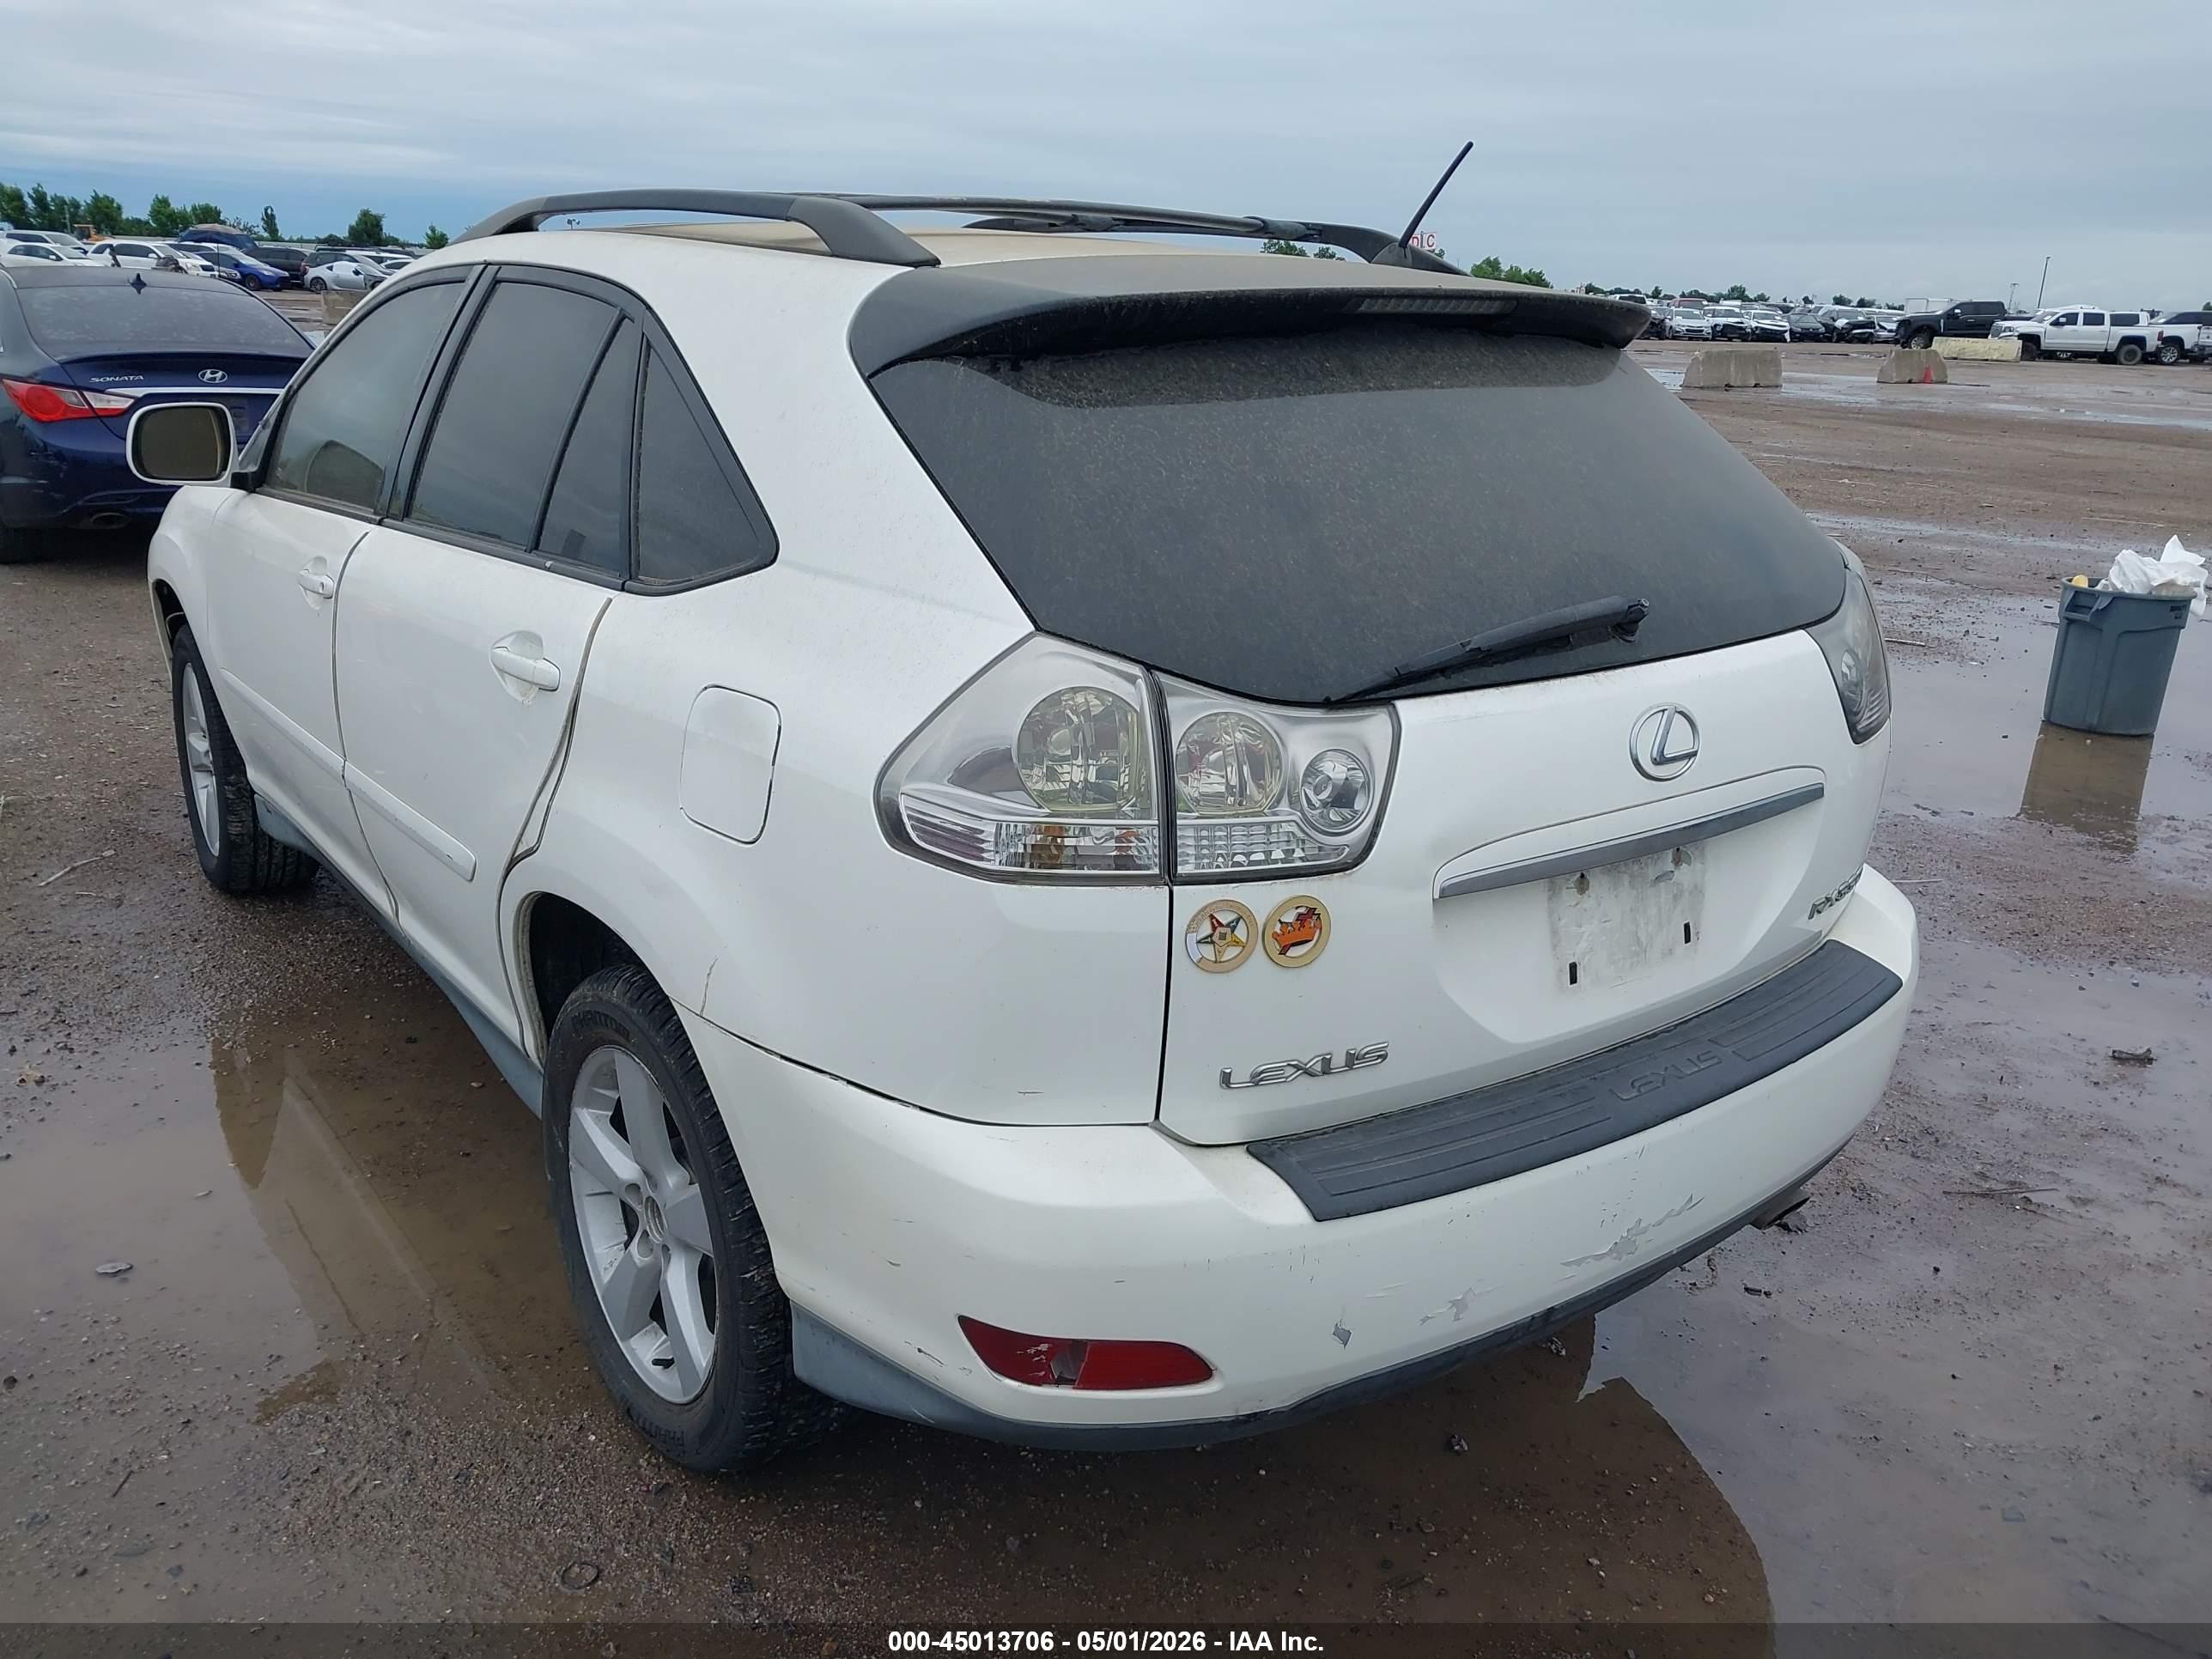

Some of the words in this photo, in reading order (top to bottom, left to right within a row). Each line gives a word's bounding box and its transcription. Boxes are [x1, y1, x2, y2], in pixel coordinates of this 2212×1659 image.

[88, 374, 144, 383] SONATA
[1219, 1042, 1389, 1089] LEXUS
[1608, 1050, 1723, 1101] LEXUS
